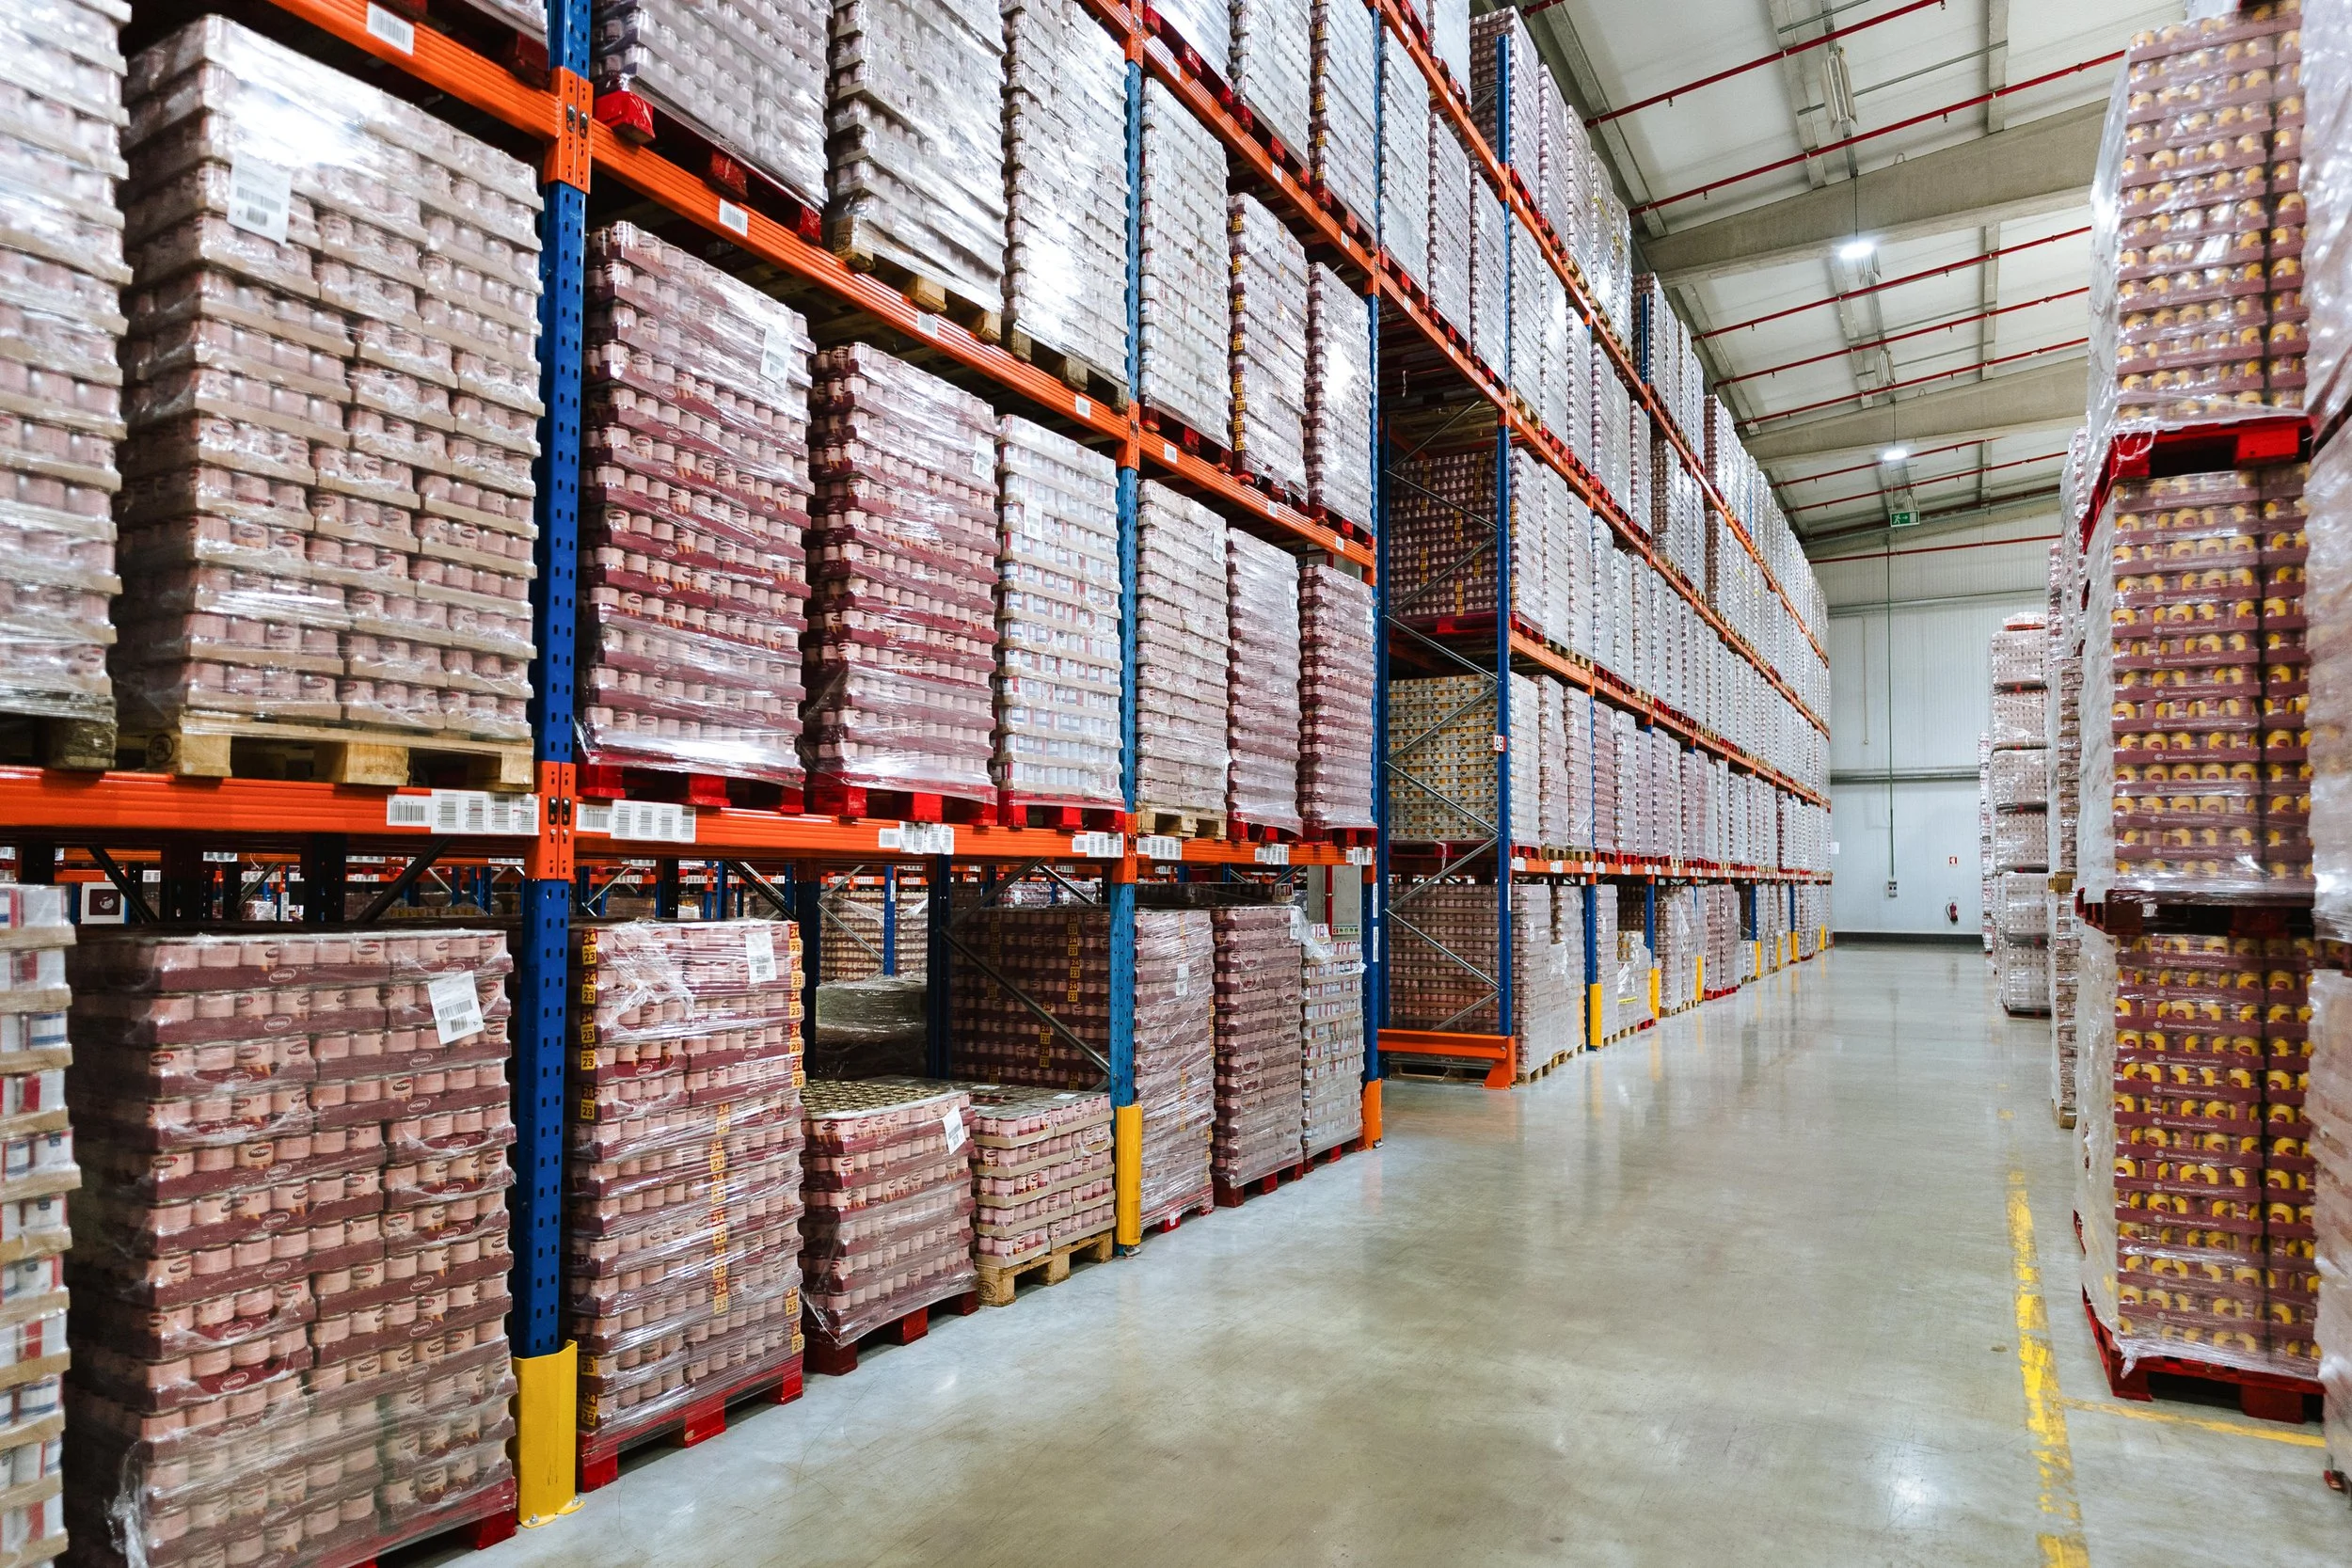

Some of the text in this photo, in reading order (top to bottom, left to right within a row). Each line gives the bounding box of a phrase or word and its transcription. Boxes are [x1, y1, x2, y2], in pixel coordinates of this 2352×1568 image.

[1496, 737, 1502, 750] A9
[584, 932, 596, 943] 24
[584, 952, 595, 960] 23
[584, 973, 596, 982] 24
[793, 977, 802, 986] 23
[583, 991, 595, 1001] 23
[583, 1013, 593, 1022] 24
[583, 1031, 594, 1040] 23
[790, 1027, 800, 1036] 24
[791, 1043, 801, 1052] 23
[583, 1058, 594, 1067] 23
[583, 1086, 595, 1096] 24
[583, 1108, 593, 1117] 23
[719, 1104, 729, 1115] 24
[713, 1214, 724, 1224] 24
[715, 1231, 725, 1242] 23
[715, 1266, 724, 1275] 23
[717, 1283, 727, 1293] 24
[717, 1301, 727, 1310] 23
[787, 1302, 798, 1312] 23
[793, 1340, 802, 1350] 23
[583, 1364, 594, 1372] 23
[585, 1393, 596, 1404] 24
[583, 1414, 594, 1422] 23
